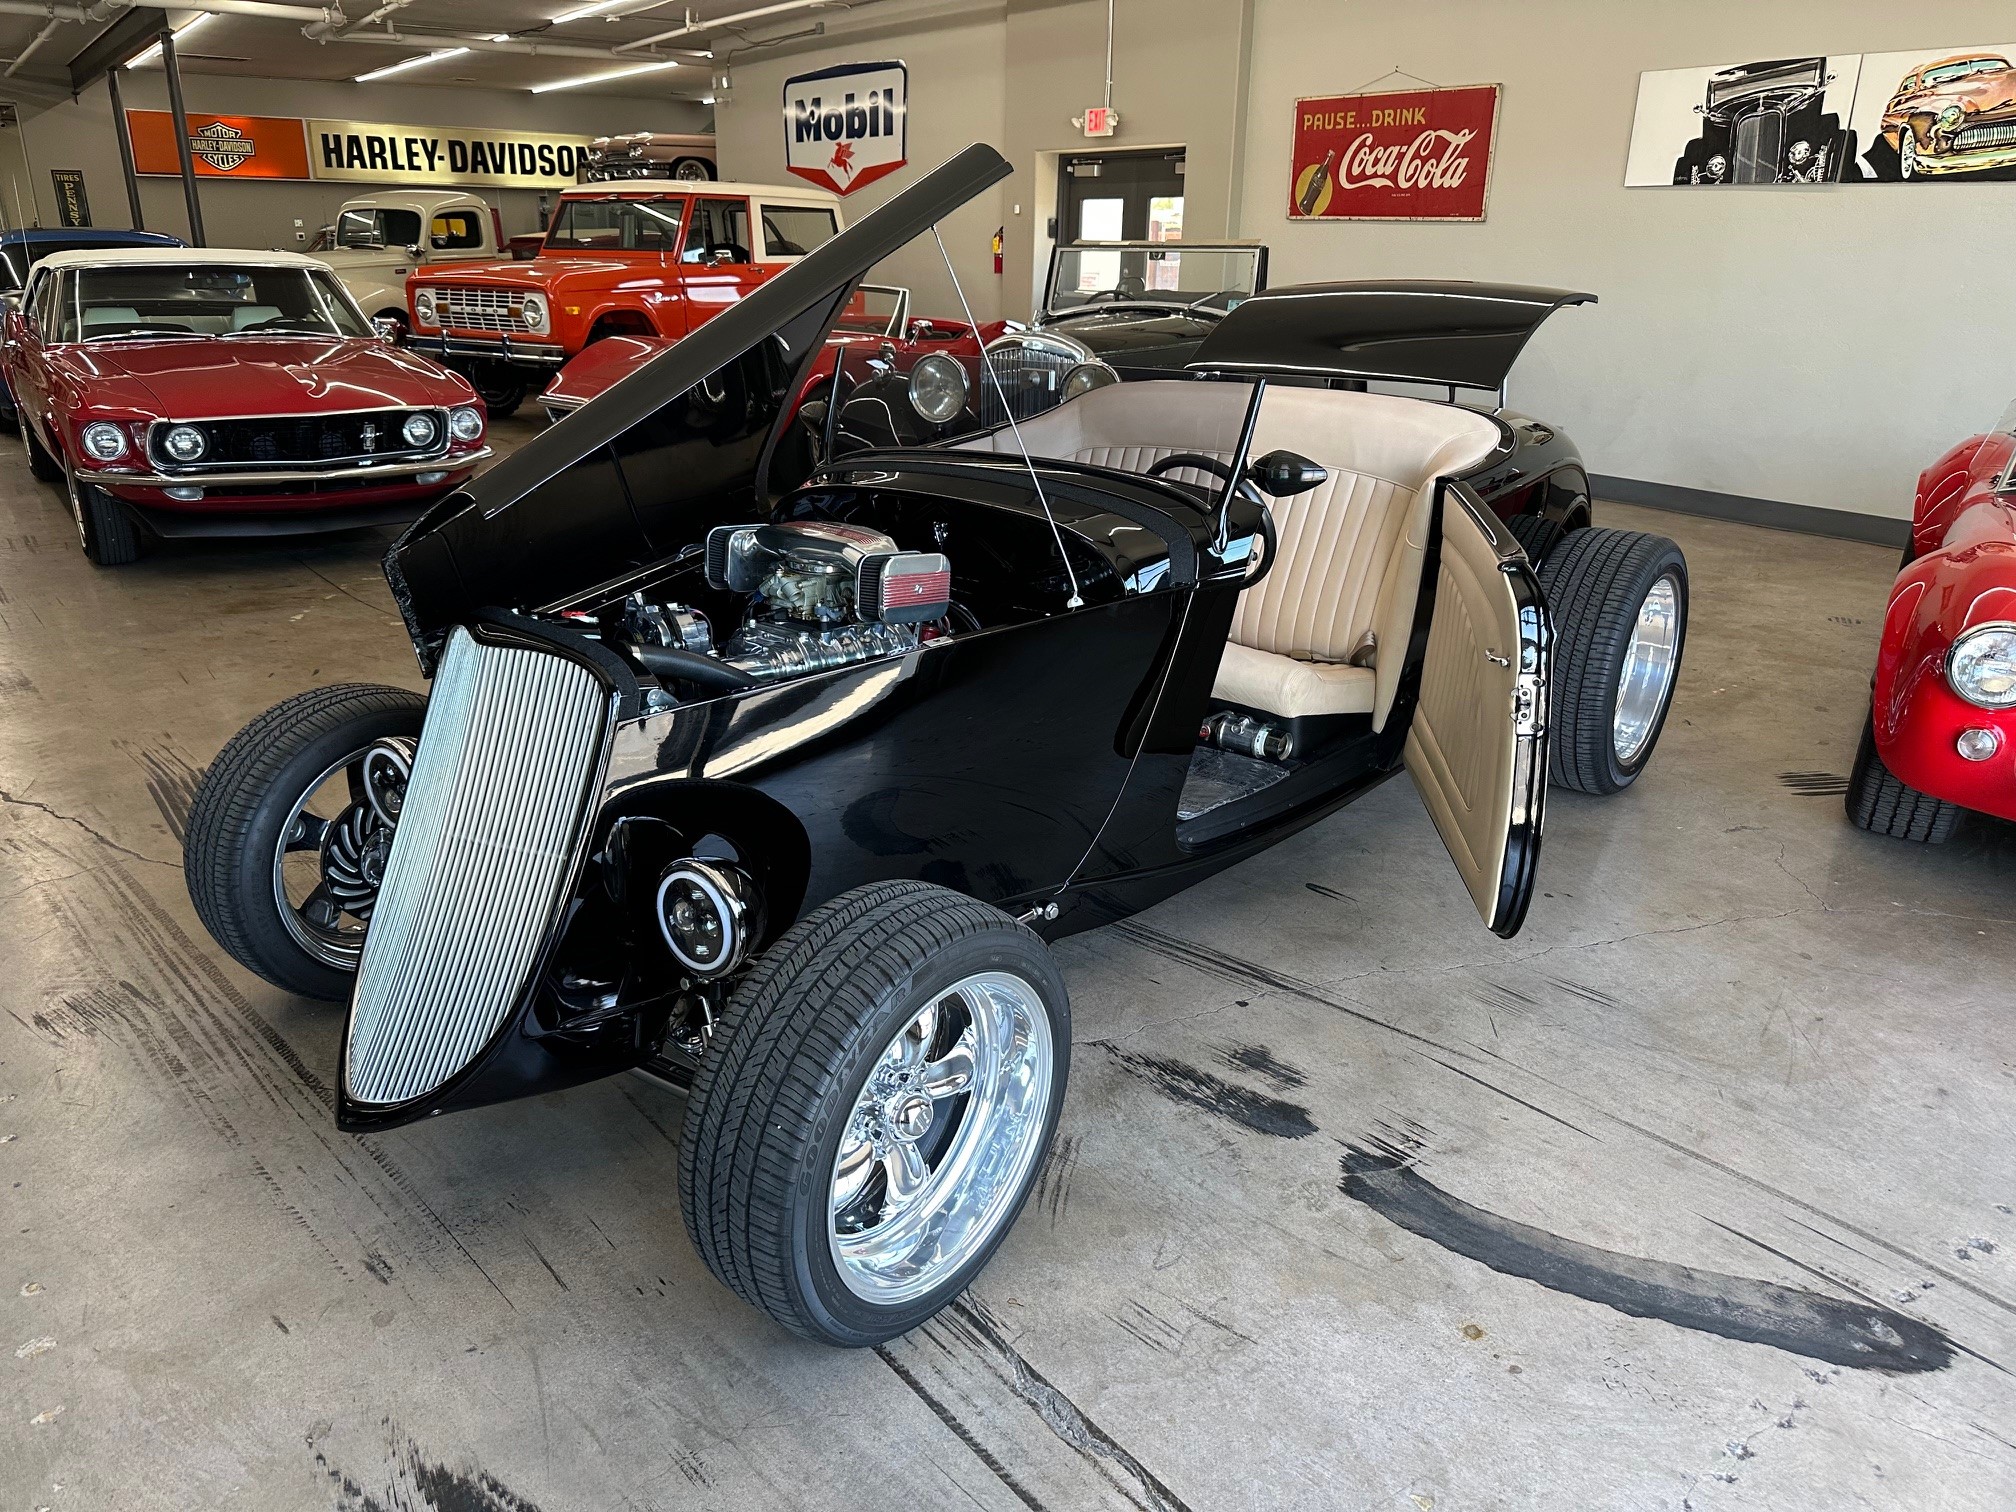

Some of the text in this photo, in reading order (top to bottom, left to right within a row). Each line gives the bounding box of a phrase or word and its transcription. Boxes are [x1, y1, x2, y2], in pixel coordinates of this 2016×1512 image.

[795, 88, 893, 142] Mobil
[1088, 109, 1106, 131] EXIT
[204, 126, 236, 138] MOTOR
[191, 140, 252, 153] HARLEY-DAVIDSON
[207, 153, 239, 168] CYCLES
[1338, 128, 1479, 189] Coca-Cola
[55, 174, 80, 182] TIRES
[63, 182, 82, 226] PENNSY
[799, 986, 908, 1197] GOODYEAR
